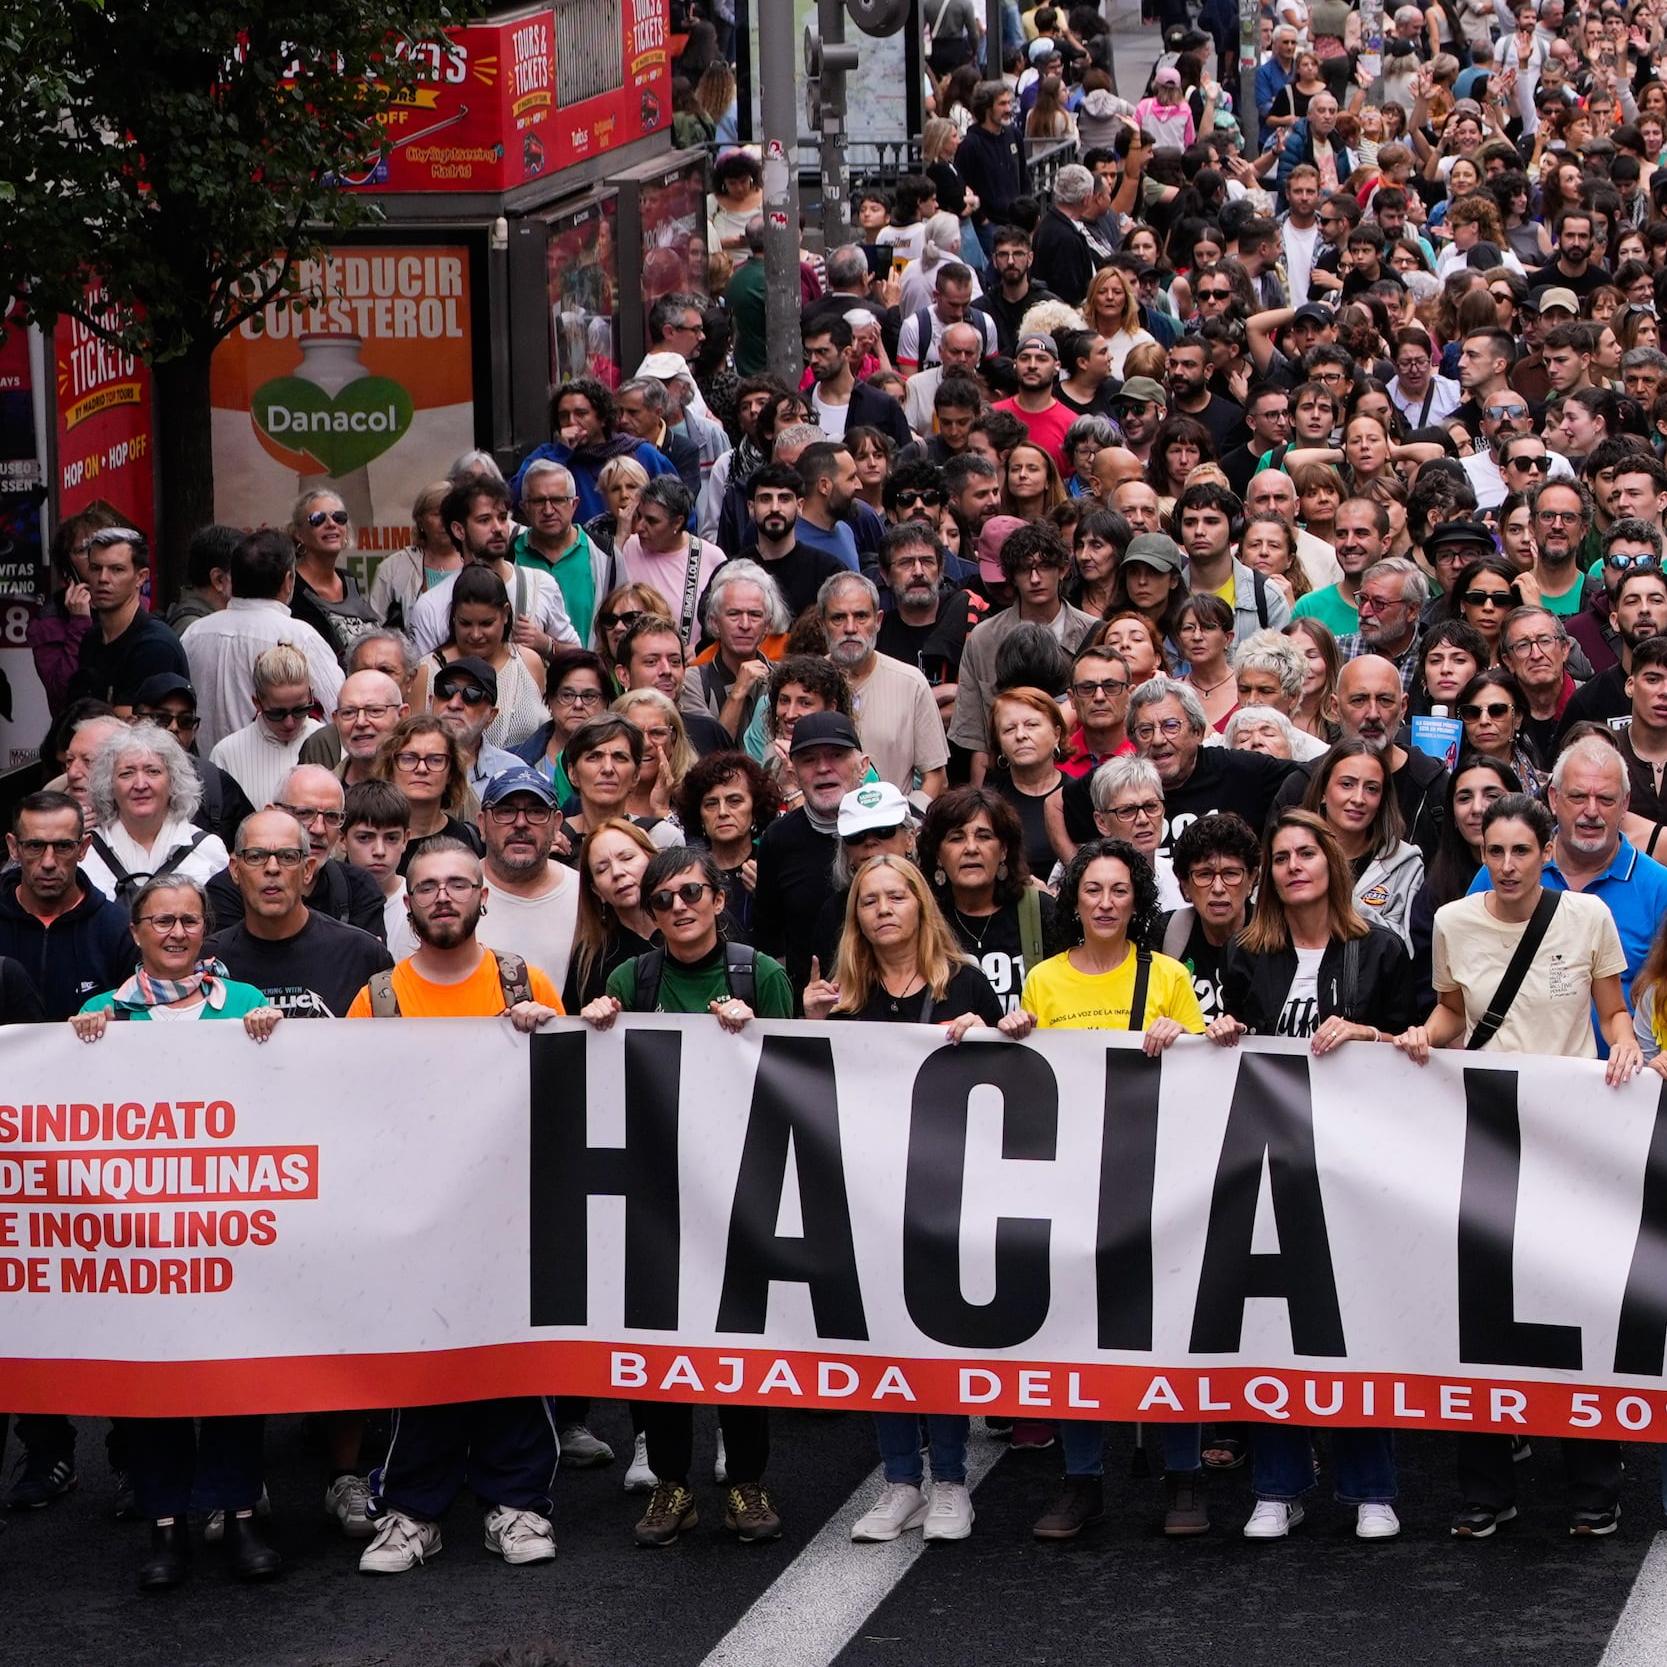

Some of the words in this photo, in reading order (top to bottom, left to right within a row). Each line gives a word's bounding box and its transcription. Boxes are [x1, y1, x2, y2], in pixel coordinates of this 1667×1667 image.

[512, 24, 540, 62] TOURS
[632, 17, 664, 55] TICKETS
[514, 57, 548, 97] TICKETS
[300, 256, 463, 297] REDUCIR
[82, 395, 106, 417] MADRID
[116, 386, 134, 403] TOURS
[267, 404, 396, 432] Danacol
[64, 462, 84, 490] HOP
[85, 454, 100, 480] ON
[109, 442, 128, 470] HOP
[129, 433, 147, 463] OFF
[285, 986, 302, 995] WITH
[1068, 1013, 1077, 1021] LA
[1078, 1011, 1092, 1019] VOZ
[0, 1100, 237, 1144] SINDICATO
[0, 1159, 47, 1197] DE
[57, 1154, 310, 1201] INQUILINAS
[528, 1028, 1348, 1358] HACIA
[0, 1212, 19, 1248] E
[29, 1209, 278, 1253] INQUILINOS
[0, 1258, 50, 1293] DE
[61, 1257, 235, 1296] MADRID
[610, 1348, 937, 1403] BAJADA
[959, 1367, 1101, 1411] DEL
[1138, 1373, 1529, 1426] ALQUILER
